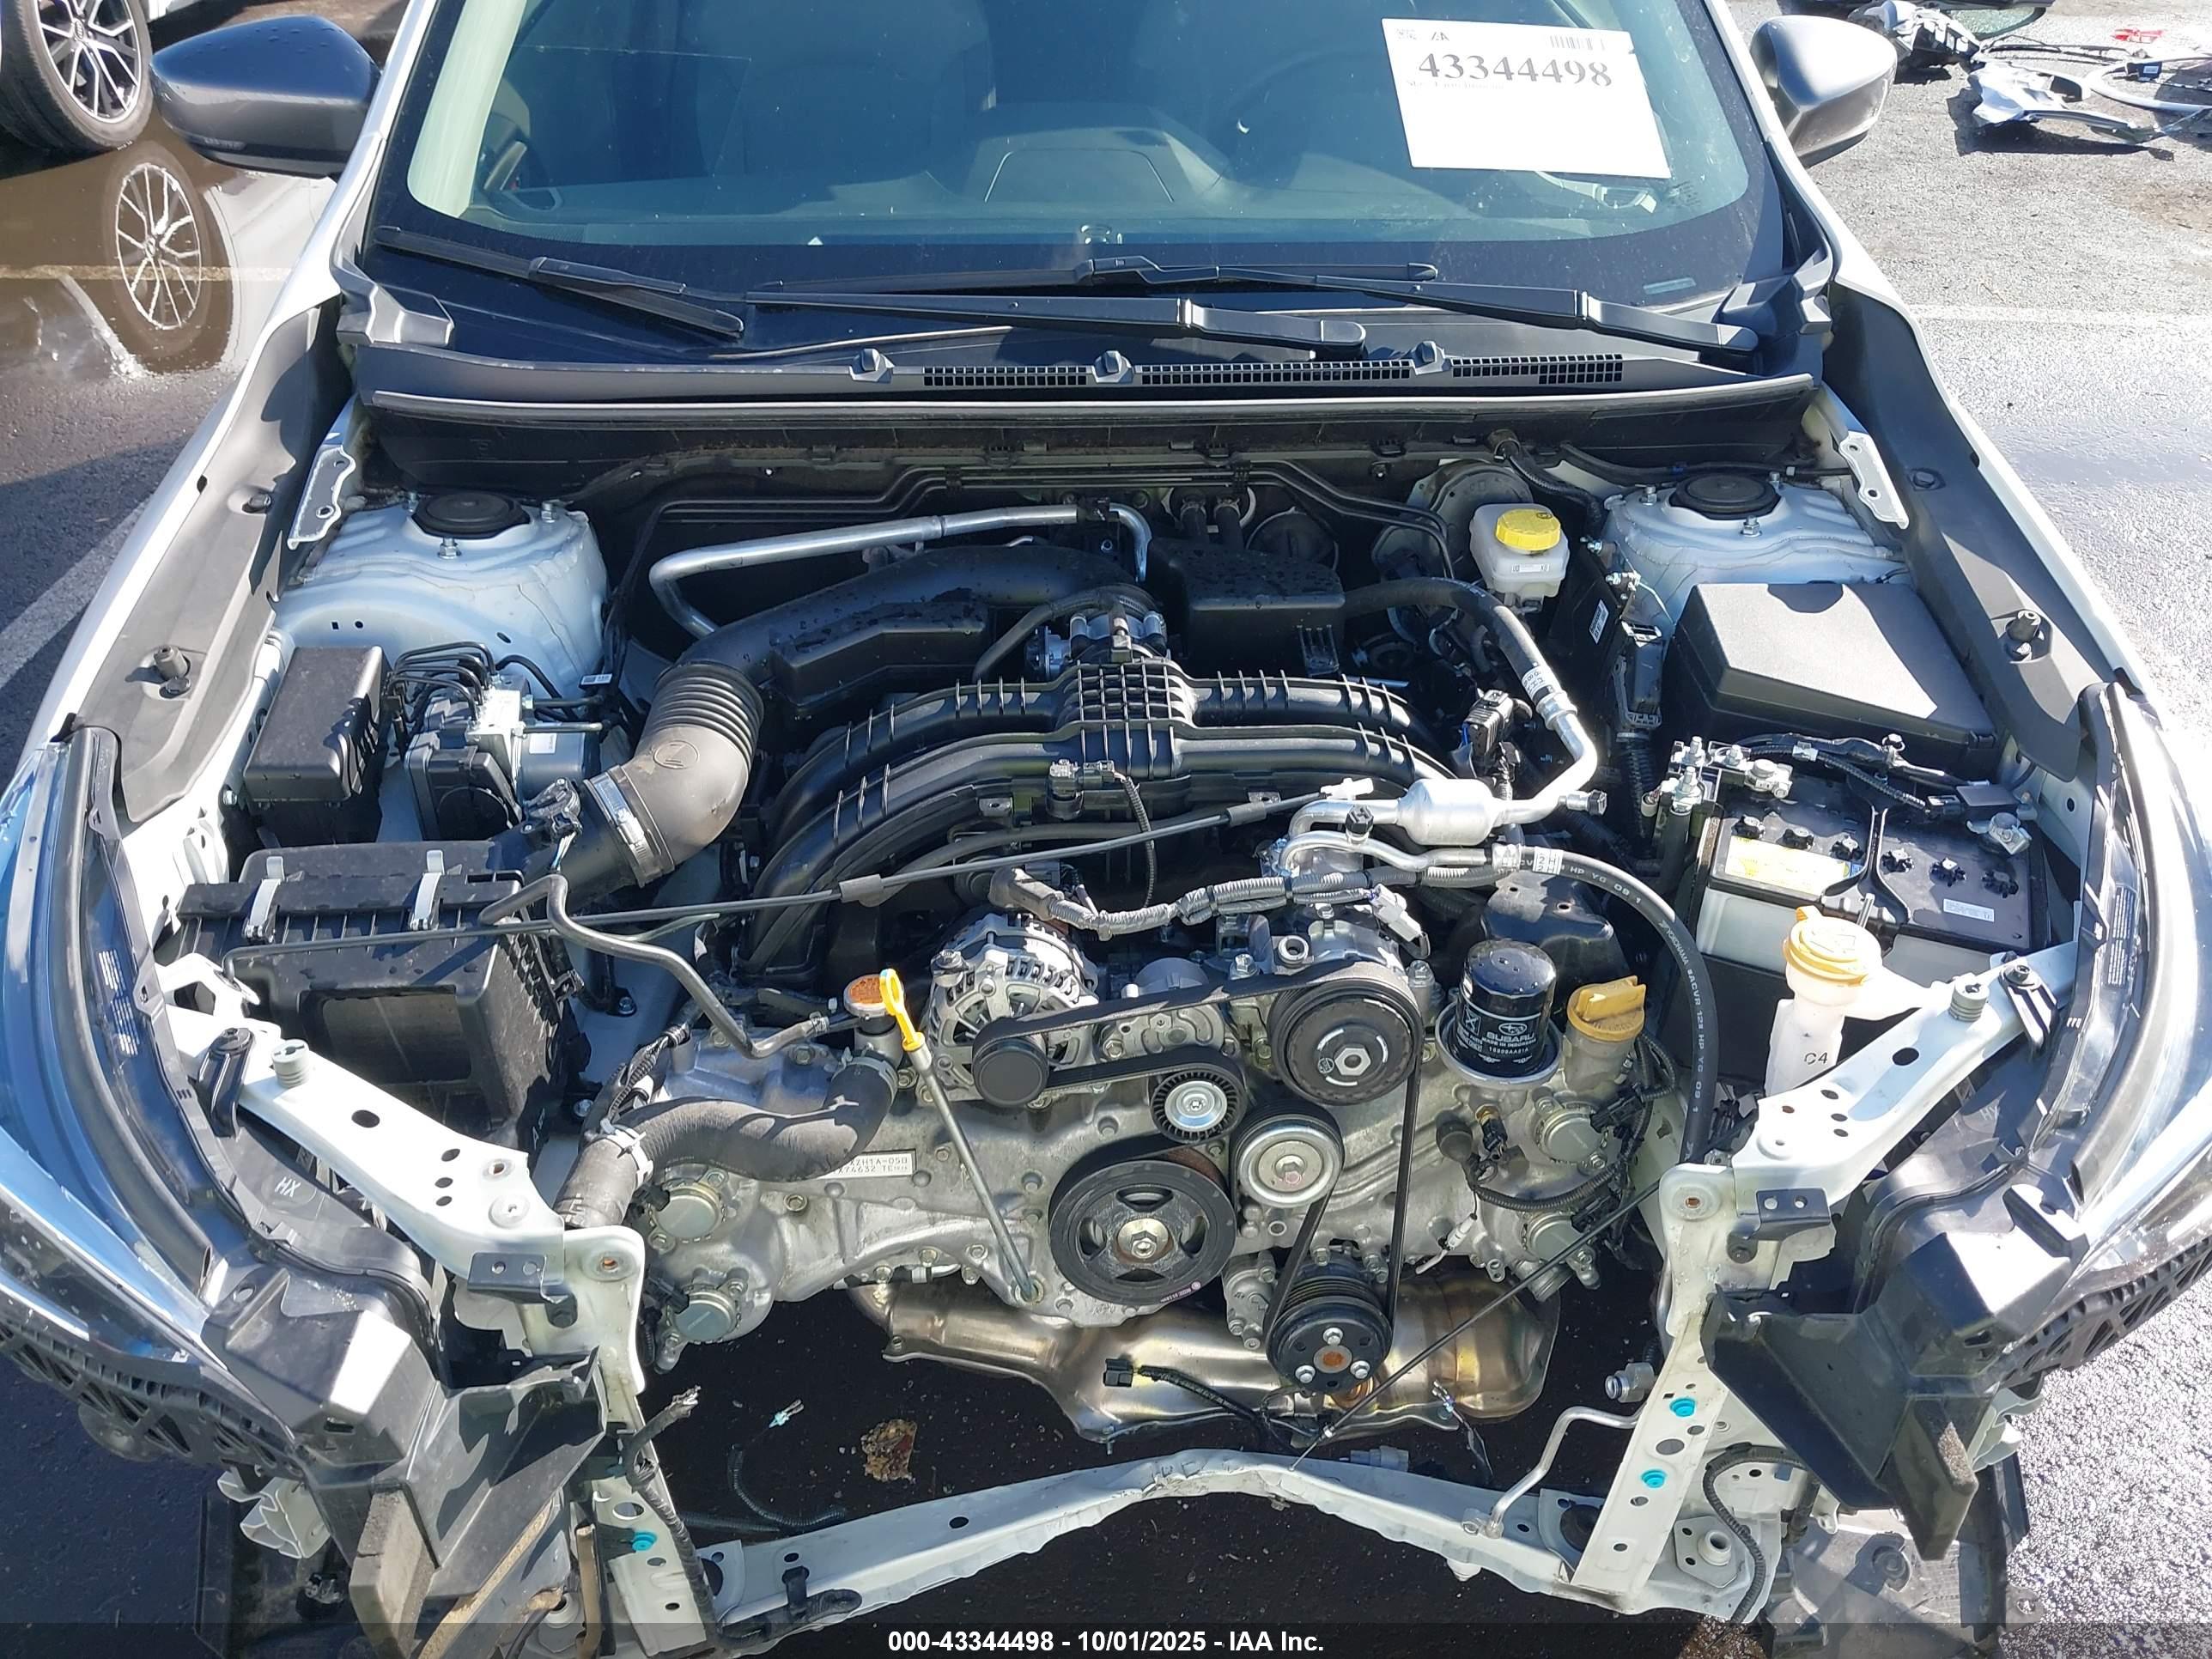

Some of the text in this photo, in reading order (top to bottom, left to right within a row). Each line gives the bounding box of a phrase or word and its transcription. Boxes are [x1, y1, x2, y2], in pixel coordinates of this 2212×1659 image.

[1419, 52, 1612, 87] 43344498
[1481, 1036, 1498, 1046] MADE
[1486, 1031, 1535, 1042] SUBARU
